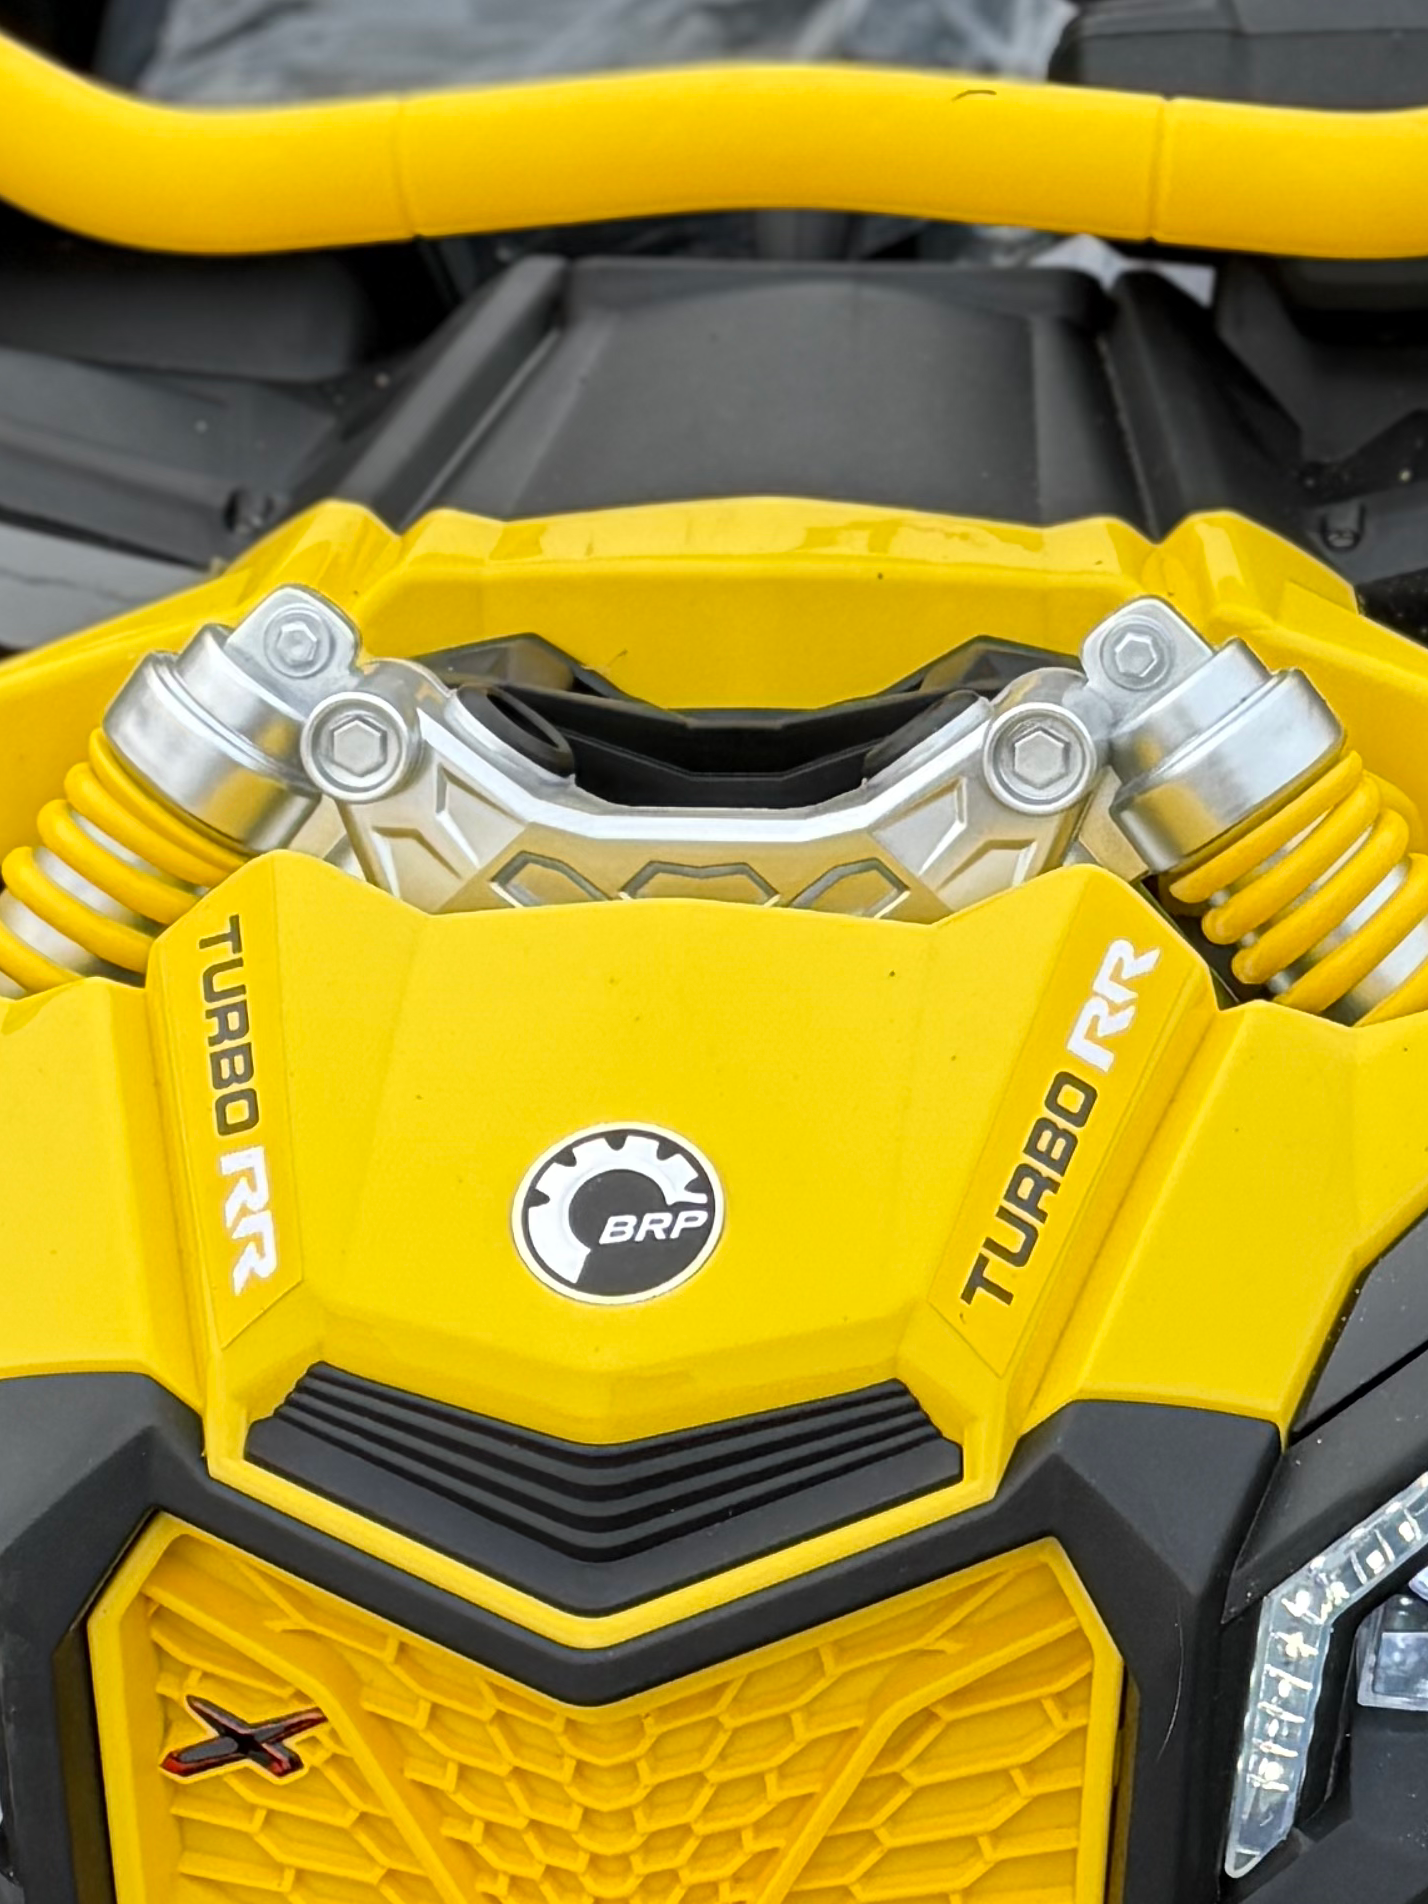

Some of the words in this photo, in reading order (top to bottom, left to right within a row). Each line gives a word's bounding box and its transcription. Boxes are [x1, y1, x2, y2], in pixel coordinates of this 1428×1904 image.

[198, 915, 261, 1137] TURBO
[960, 1071, 1099, 1307] TURBO
[1067, 938, 1160, 1074] RR
[220, 1146, 277, 1294] RR
[598, 1208, 710, 1246] BRP
